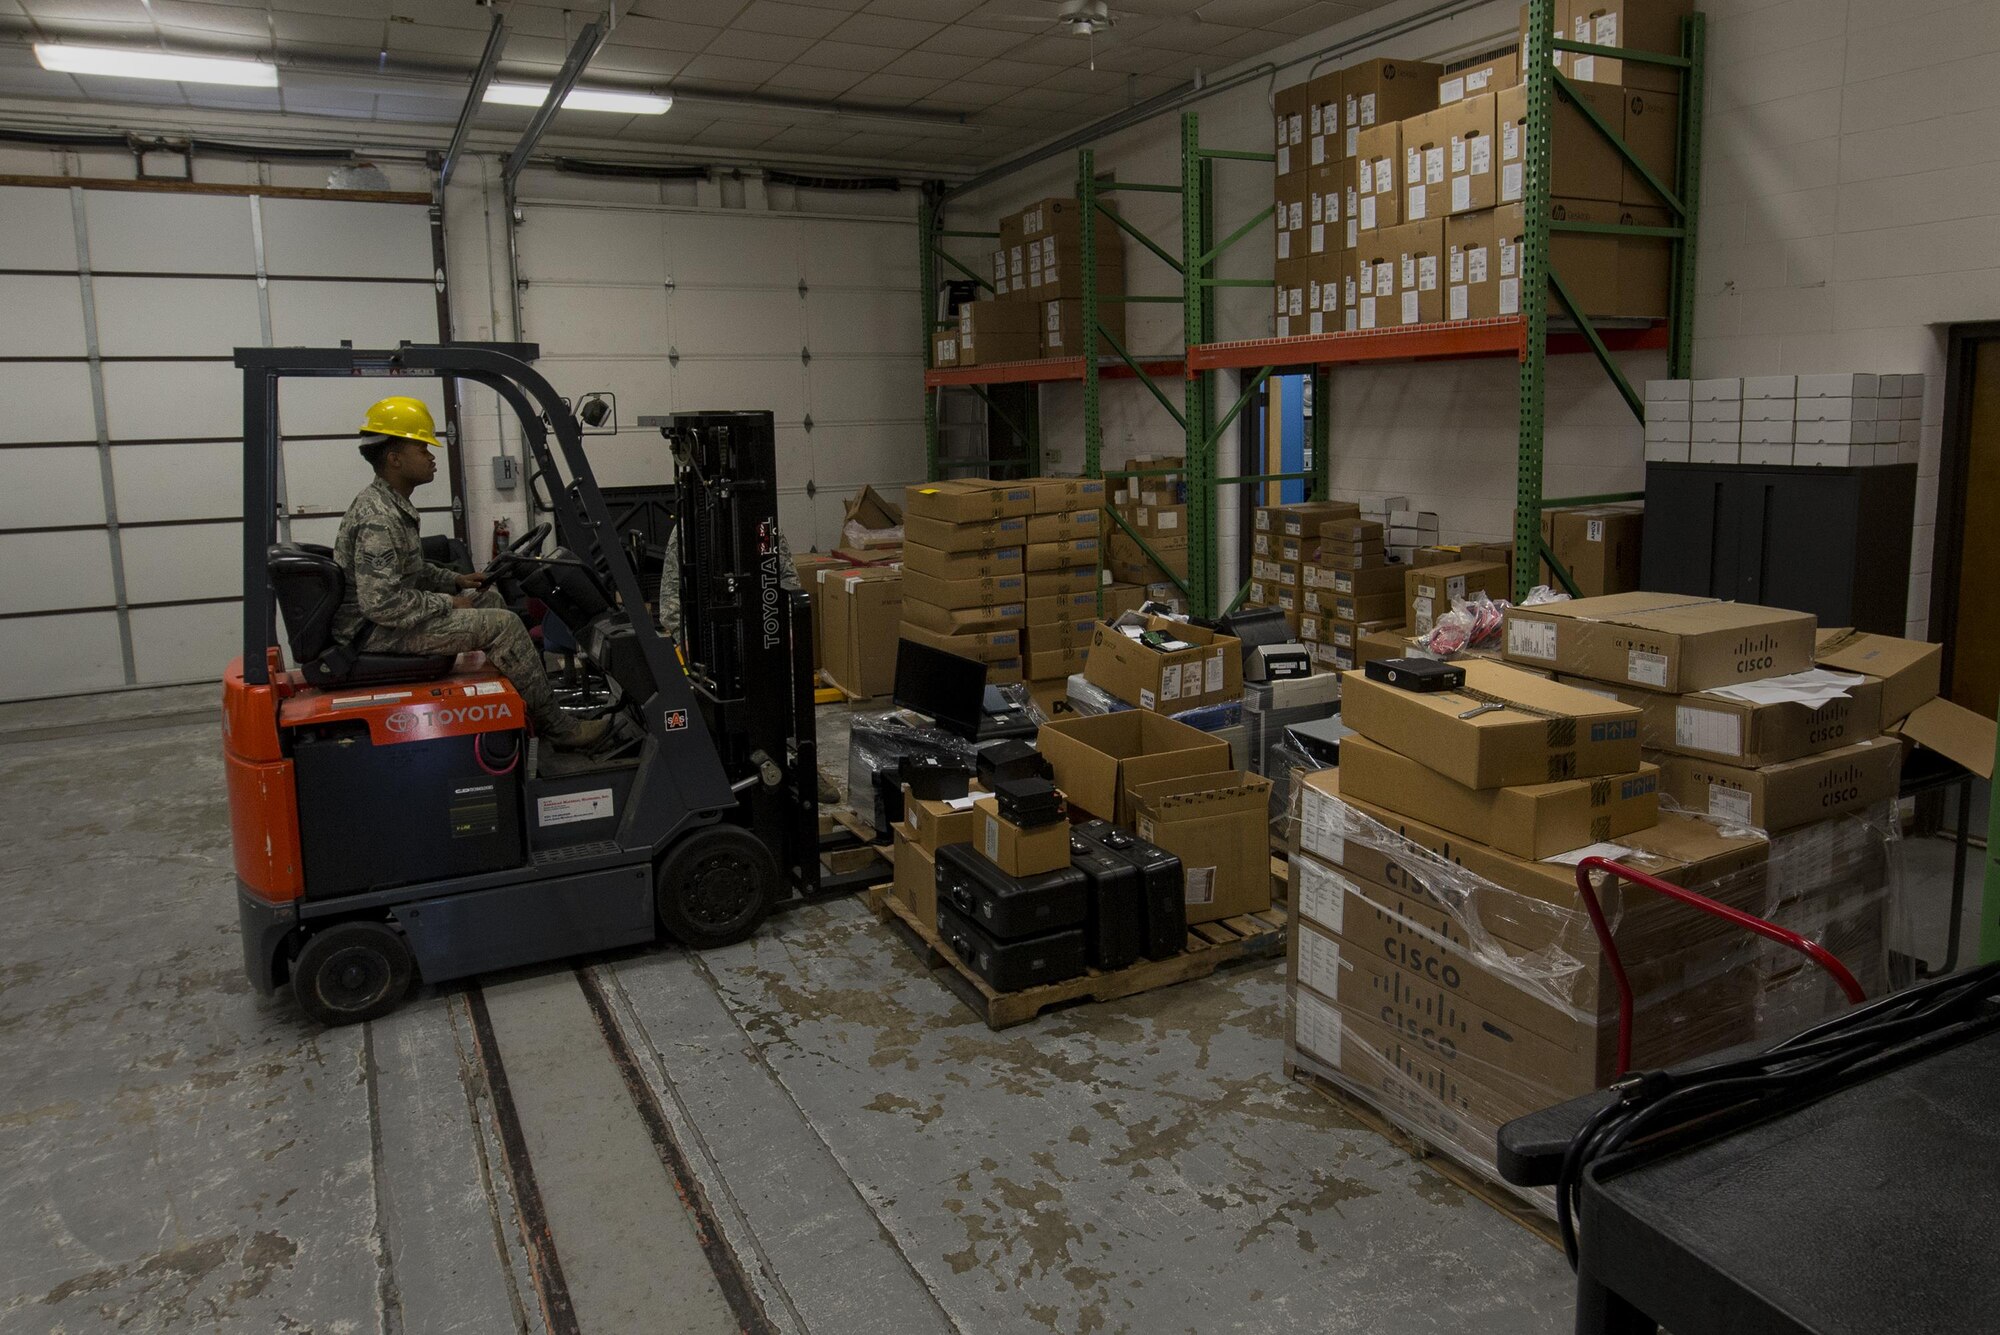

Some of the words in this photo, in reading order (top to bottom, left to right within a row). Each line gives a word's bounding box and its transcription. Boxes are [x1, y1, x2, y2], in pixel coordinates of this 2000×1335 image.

[761, 557, 780, 650] TOYOTA
[1737, 656, 1773, 673] CISCO
[423, 703, 512, 726] TOYOTA
[1809, 724, 1844, 744] CISCO
[1822, 787, 1858, 807] CISCO
[1385, 861, 1461, 909] CIS
[1384, 937, 1460, 989] CISCO
[1381, 1006, 1457, 1060] CISCO
